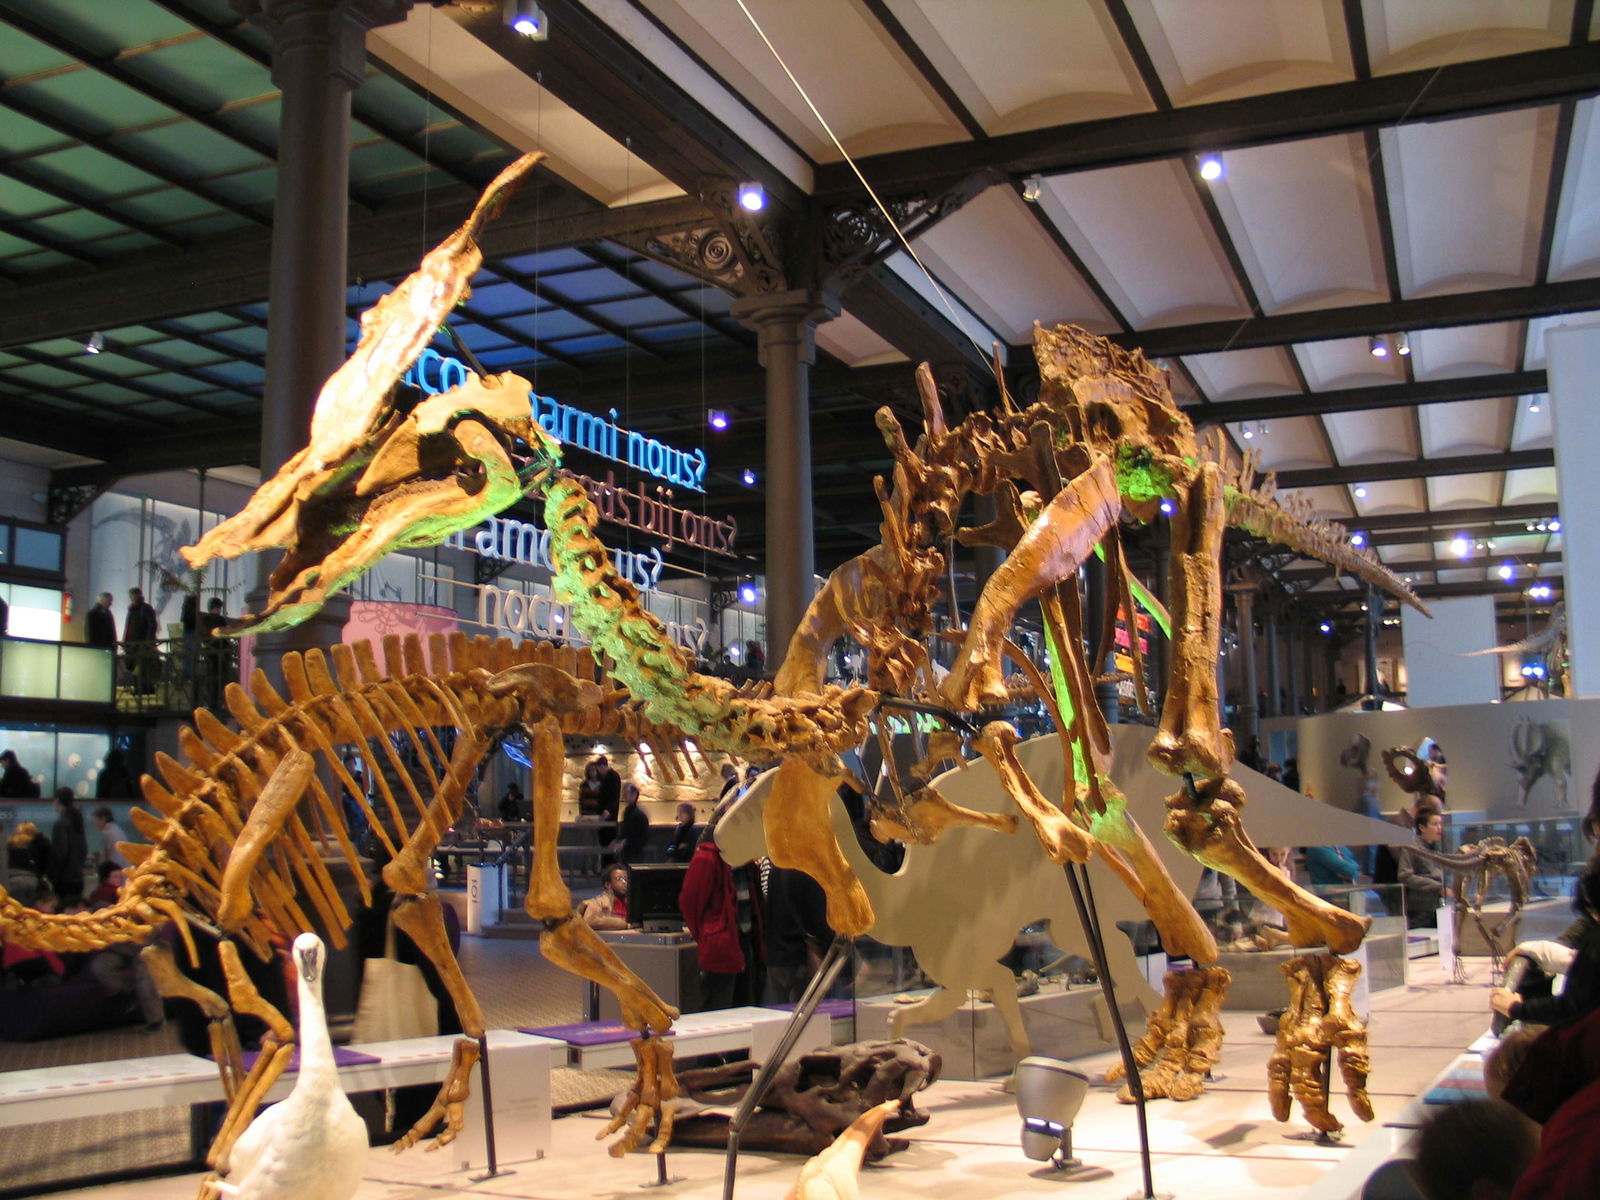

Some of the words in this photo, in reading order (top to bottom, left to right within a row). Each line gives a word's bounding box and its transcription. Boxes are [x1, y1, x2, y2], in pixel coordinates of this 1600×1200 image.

[628, 430, 708, 492] nous?
[639, 481, 674, 552] bij
[681, 509, 738, 557] ons?
[479, 577, 571, 643] noch
[664, 617, 708, 656] ns?
